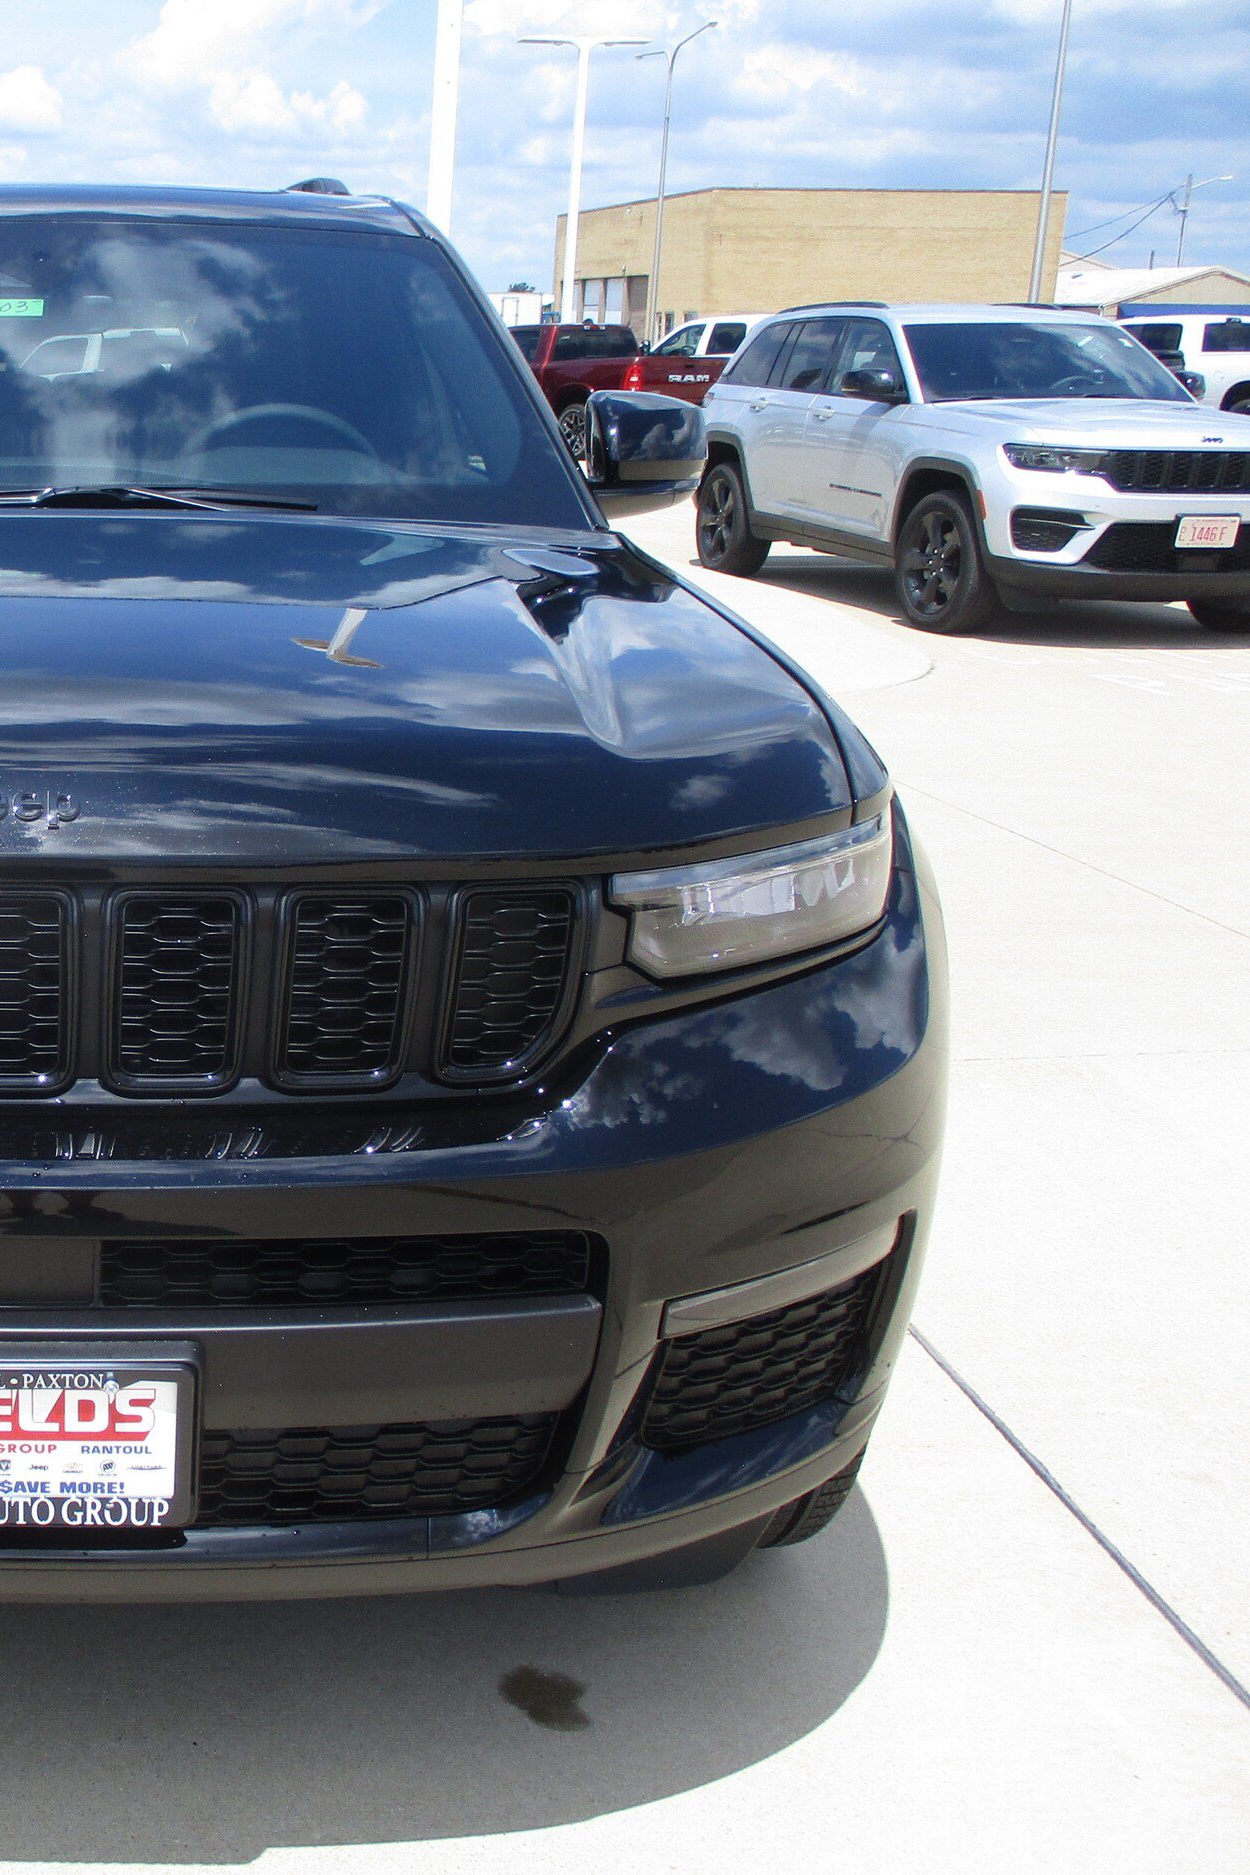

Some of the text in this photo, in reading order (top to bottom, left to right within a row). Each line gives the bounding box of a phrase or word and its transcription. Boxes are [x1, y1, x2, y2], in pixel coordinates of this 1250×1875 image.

[668, 374, 710, 383] RAM
[22, 1373, 104, 1390] PAXTON
[80, 1445, 153, 1455] RANTOUL
[28, 1463, 49, 1472] Jeep
[59, 1481, 125, 1495] MORE!
[61, 1496, 170, 1527] GROUP
